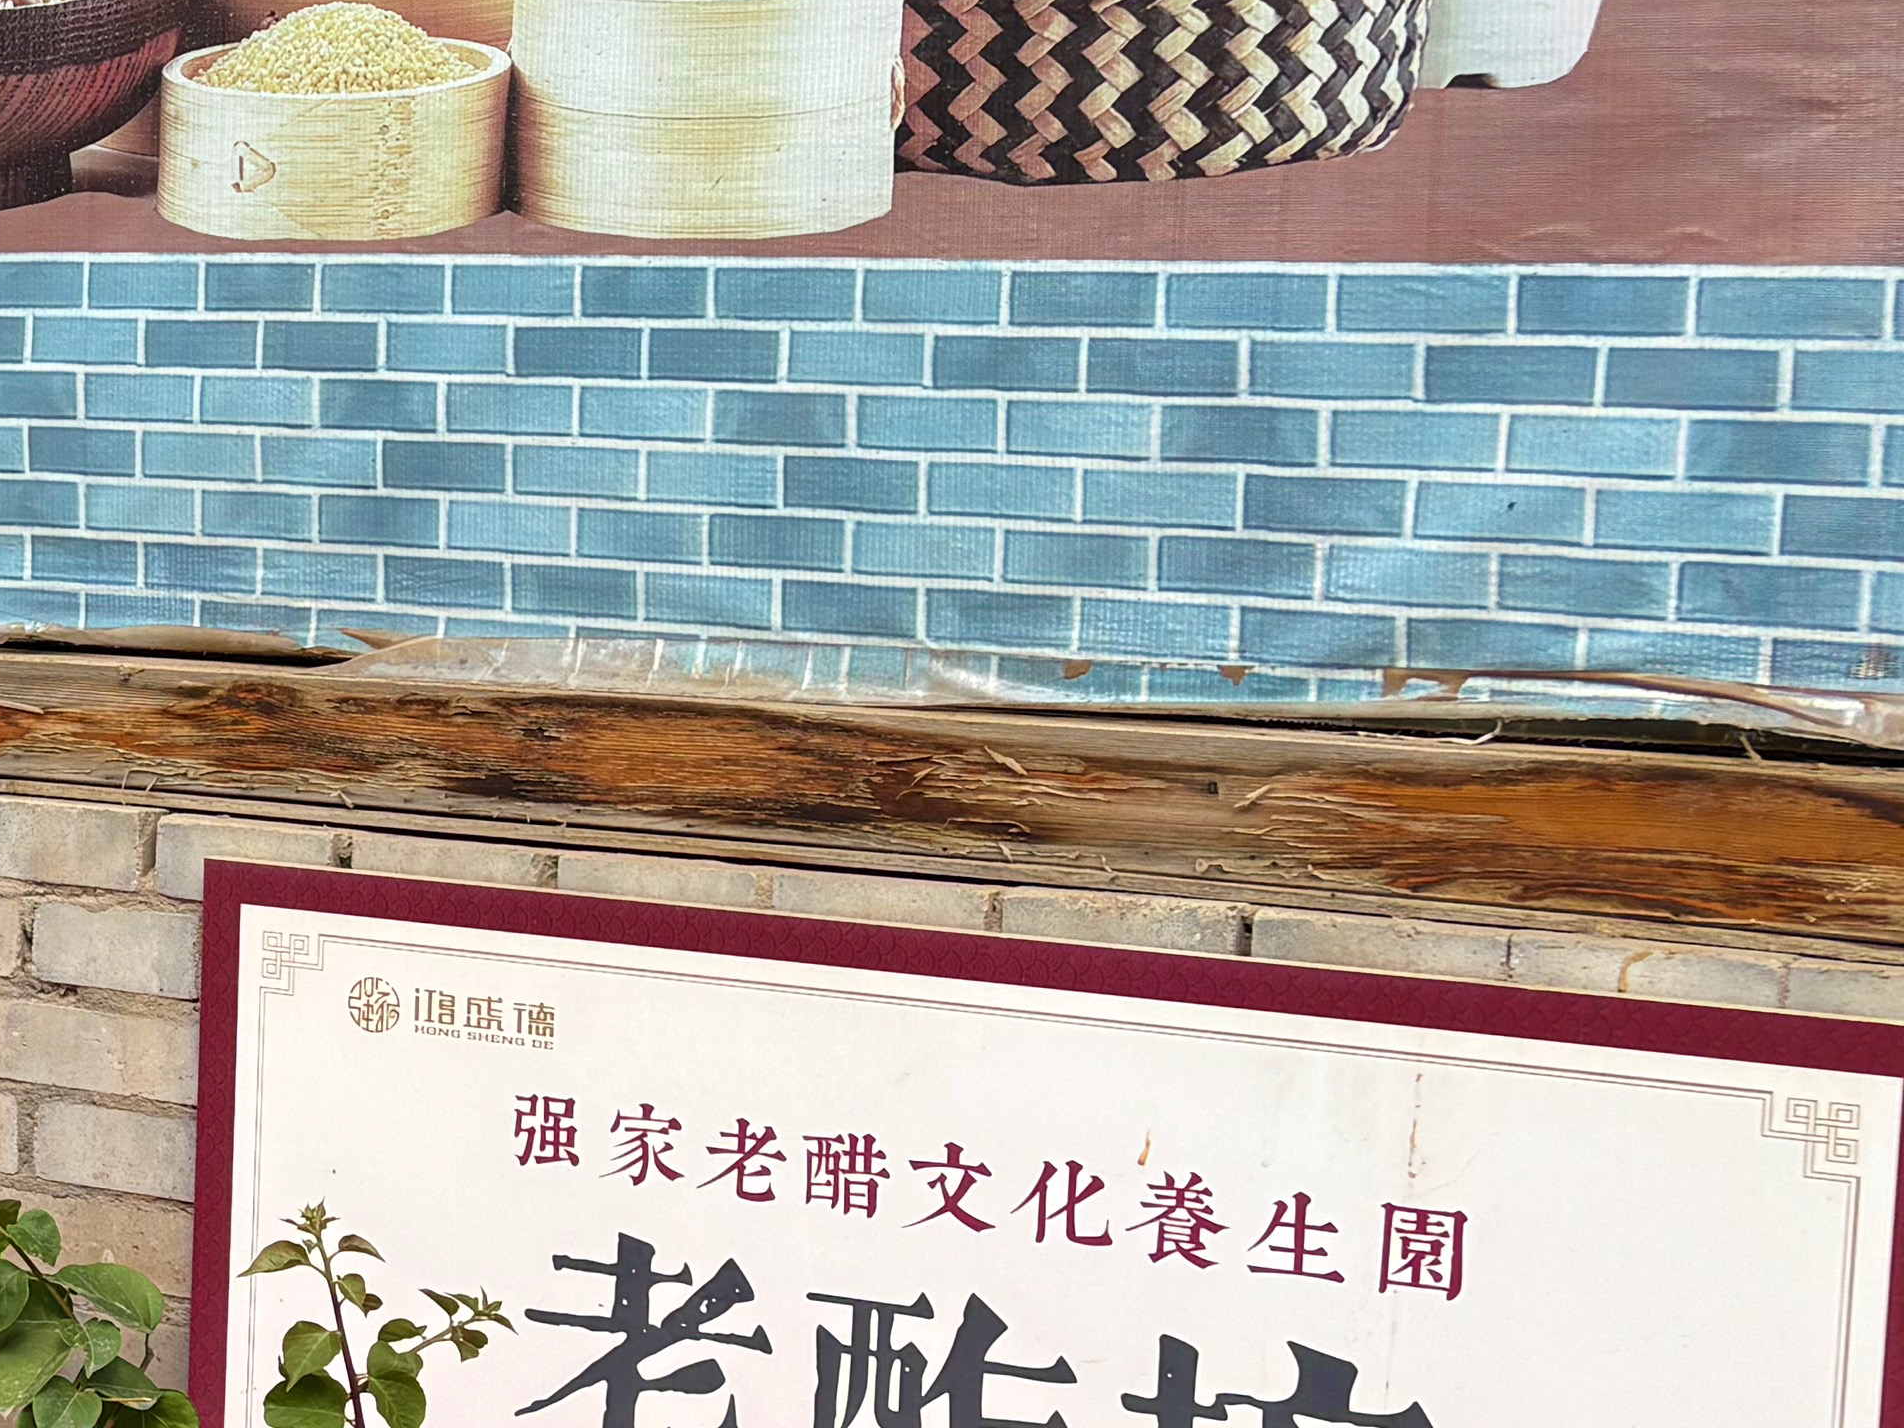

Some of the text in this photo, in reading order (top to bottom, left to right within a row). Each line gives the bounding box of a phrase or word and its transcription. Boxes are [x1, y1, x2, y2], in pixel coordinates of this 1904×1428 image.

[415, 1025, 554, 1050] HONG SHENG DE
[510, 1093, 1468, 1303] 强家老醋文化養生園
